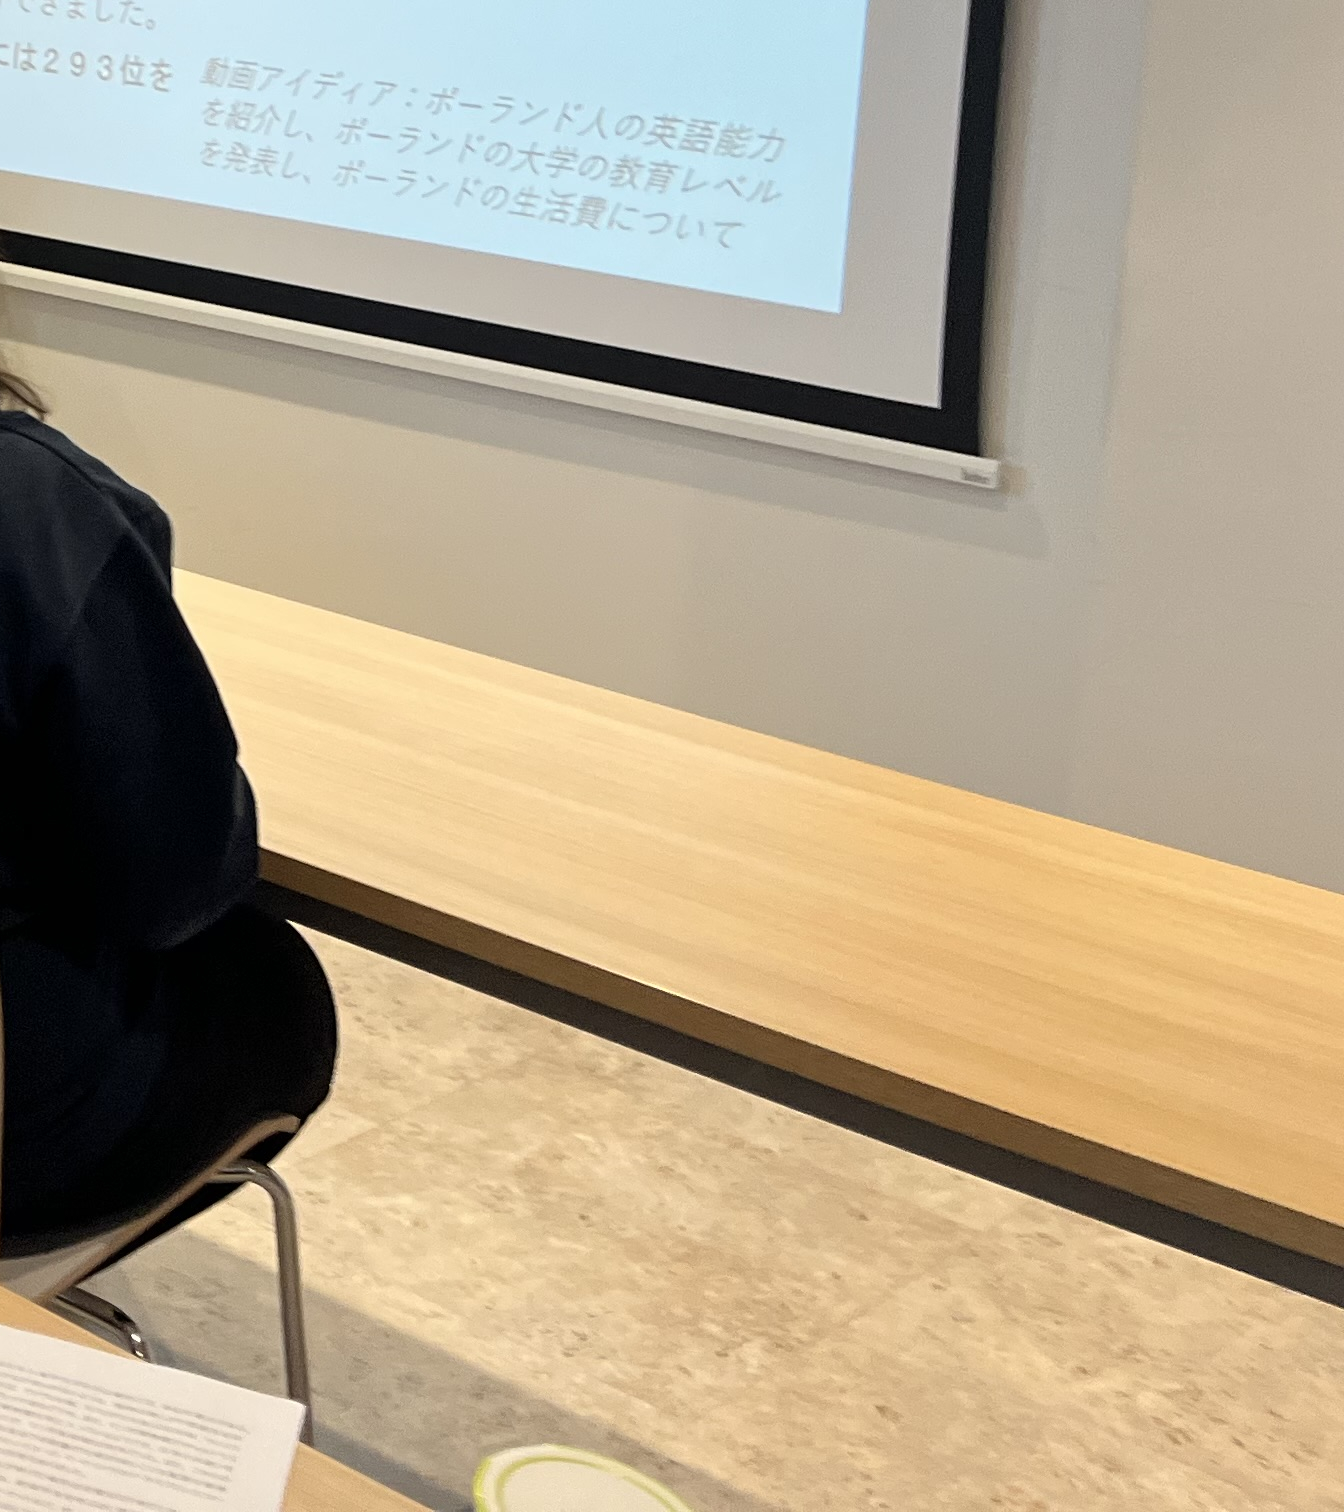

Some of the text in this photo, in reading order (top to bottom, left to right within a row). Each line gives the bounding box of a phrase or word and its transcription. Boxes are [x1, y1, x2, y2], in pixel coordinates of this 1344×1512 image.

[200, 140, 746, 249] を発表し、ポーランドの生活費について
[202, 97, 782, 205] を紹介し、ポーランドの大学の教育レベル
